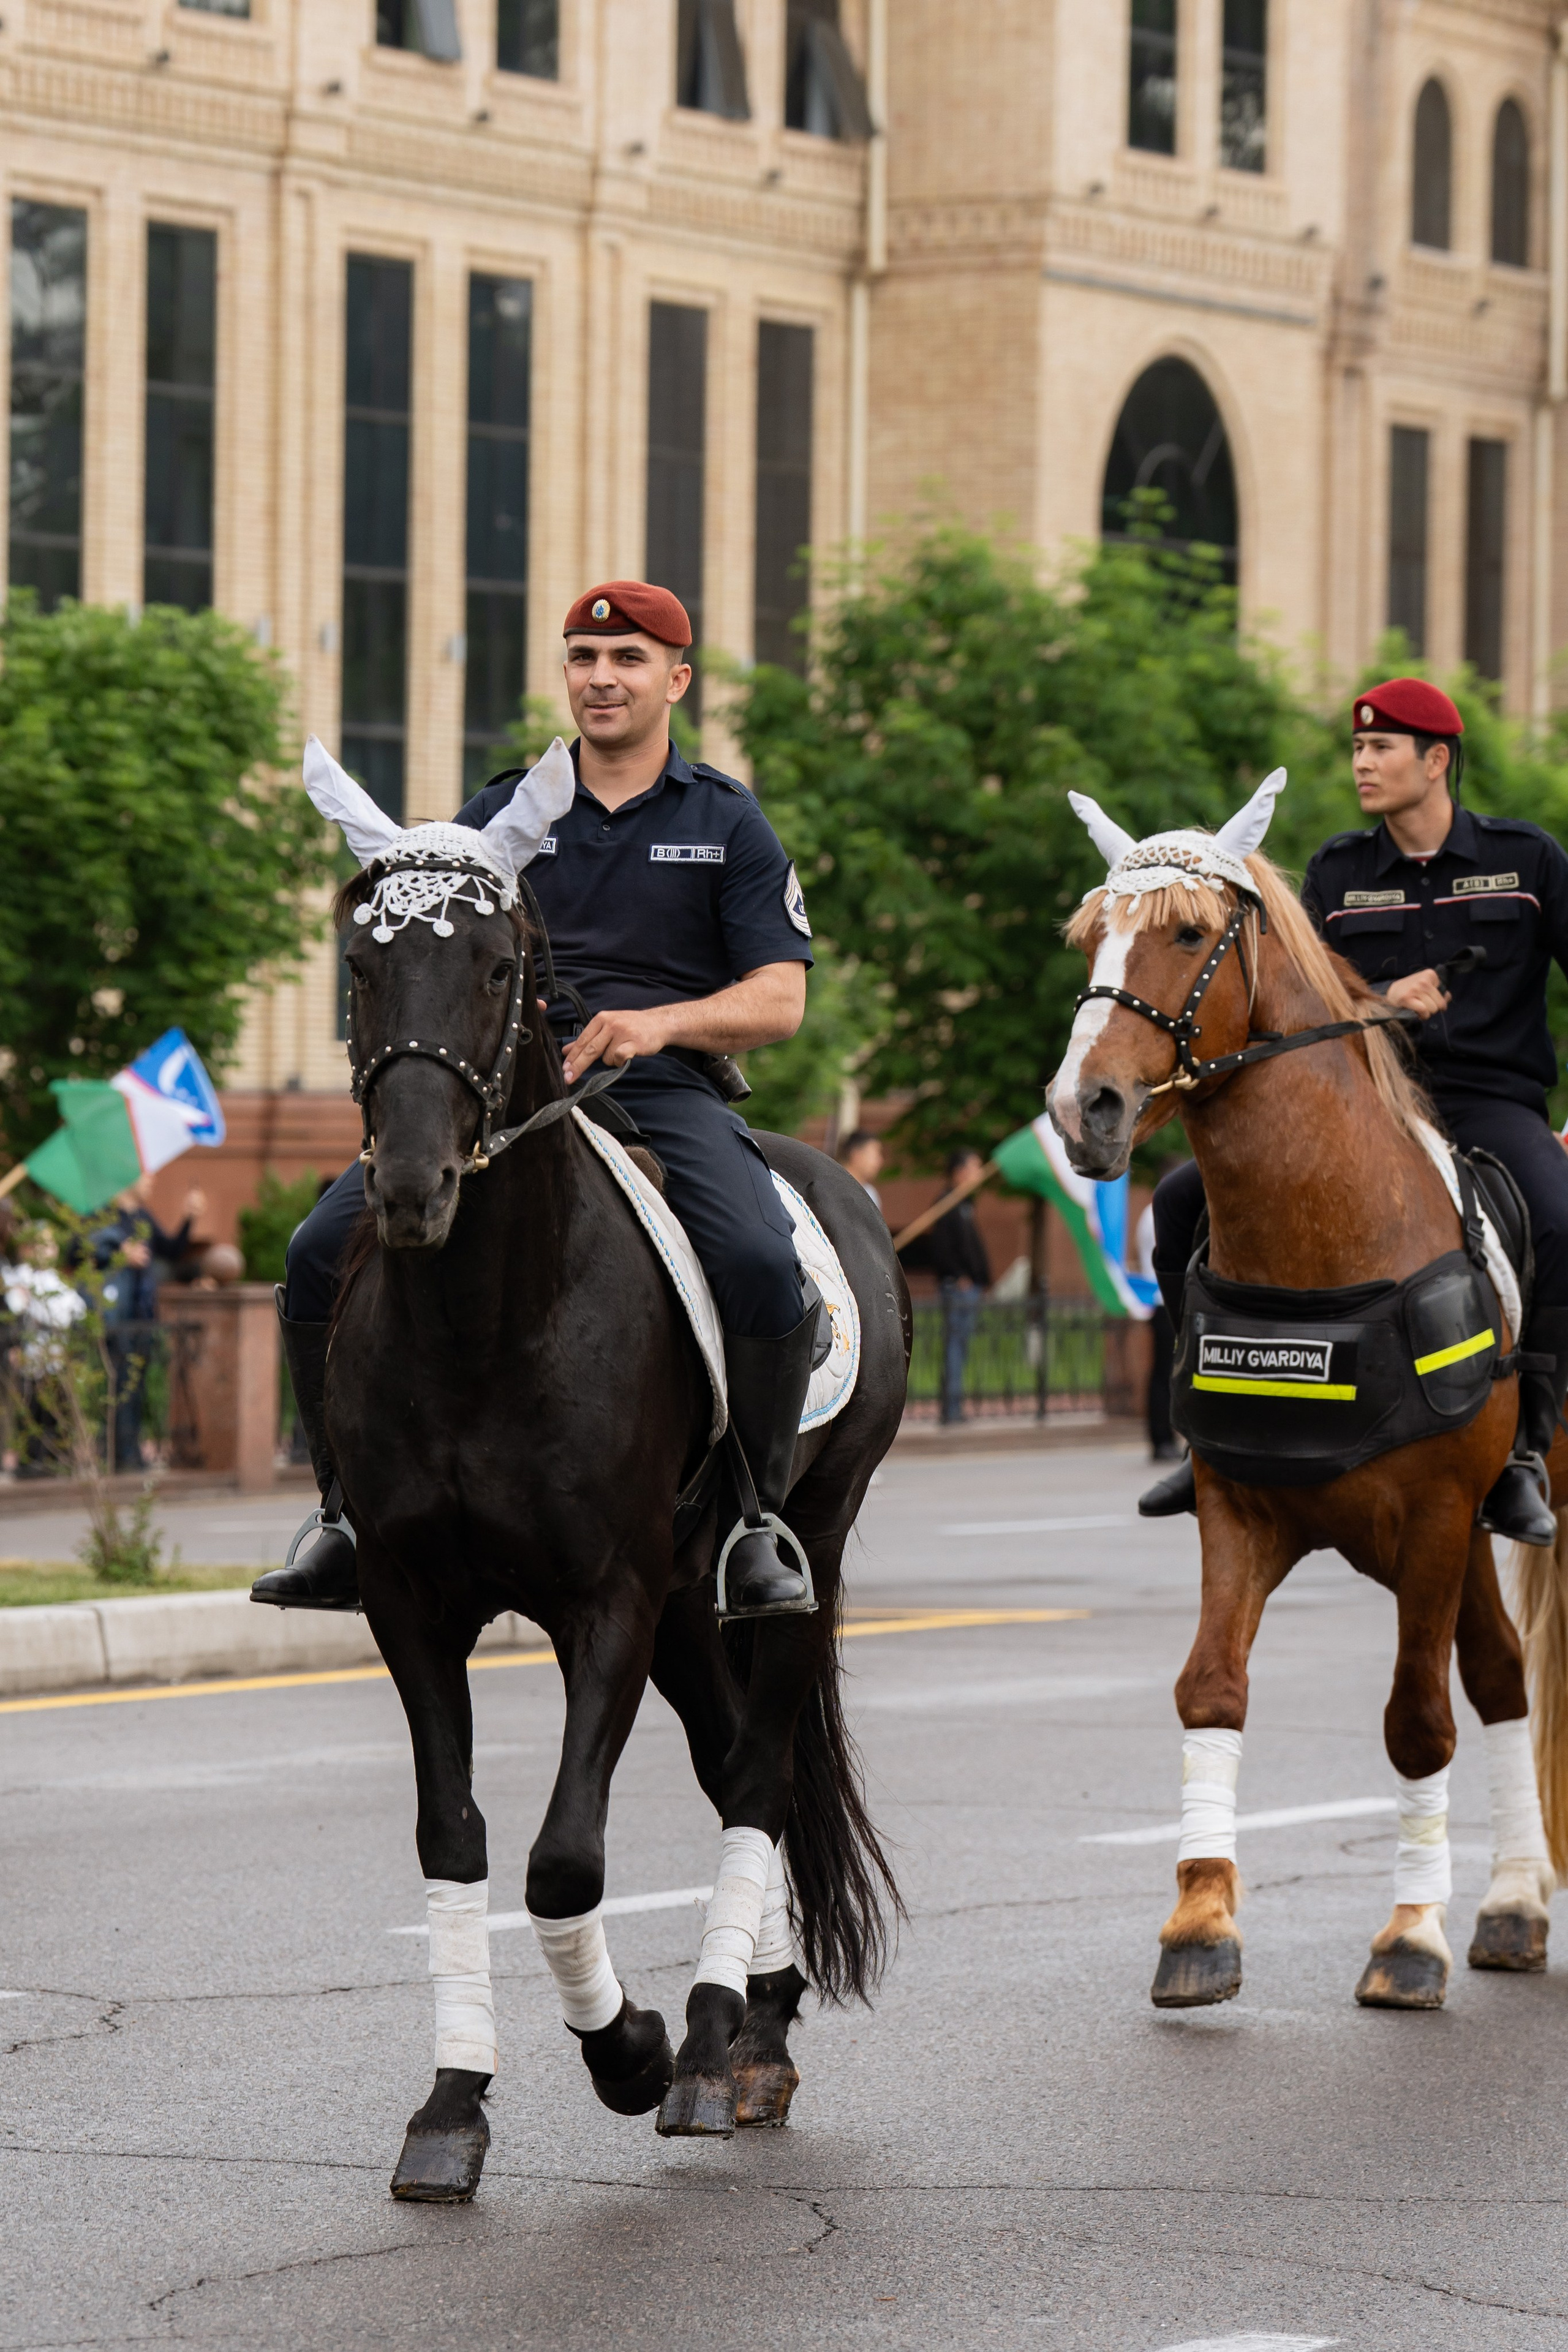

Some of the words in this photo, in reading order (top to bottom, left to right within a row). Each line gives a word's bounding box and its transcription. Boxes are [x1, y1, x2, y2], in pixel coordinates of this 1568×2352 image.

[697, 848, 720, 859] Rh+
[1203, 1346, 1246, 1366] MILLIY
[1247, 1349, 1324, 1370] GVARDIYA
